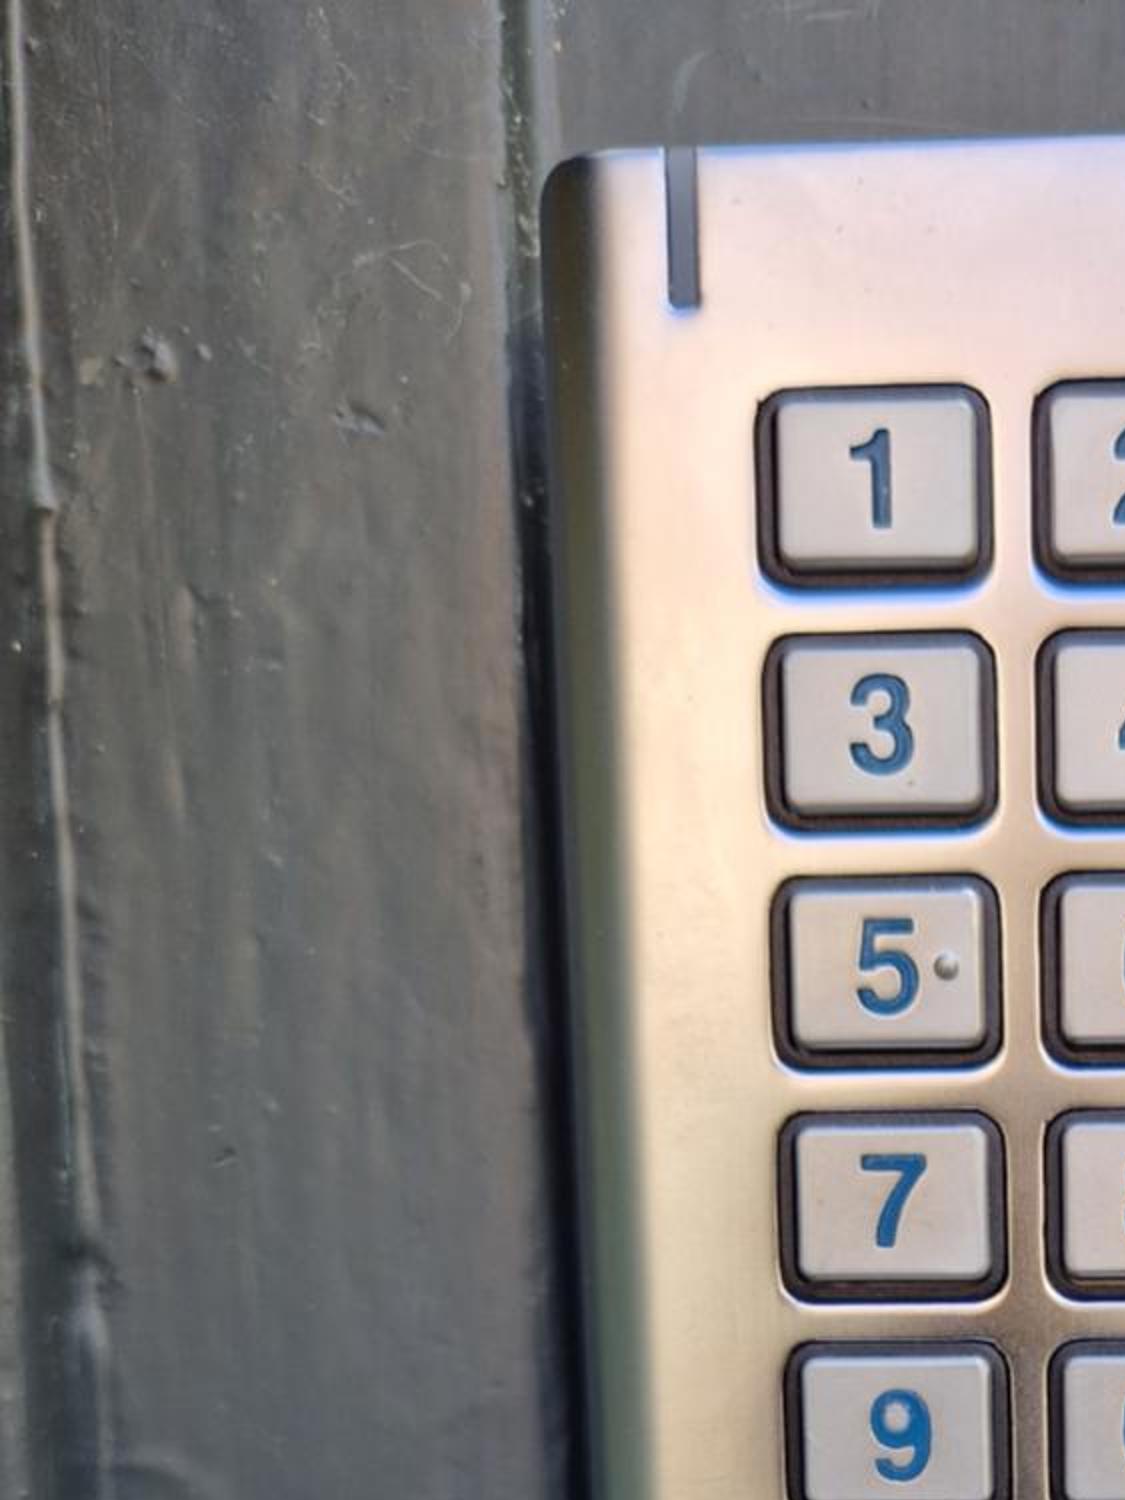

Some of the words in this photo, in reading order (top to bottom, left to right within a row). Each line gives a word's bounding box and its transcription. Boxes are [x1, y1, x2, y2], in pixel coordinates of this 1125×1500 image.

[850, 428, 890, 528] 1
[851, 674, 913, 775] 3
[857, 918, 919, 1016] 5
[862, 1152, 927, 1249] 7
[869, 1388, 934, 1482] 9
